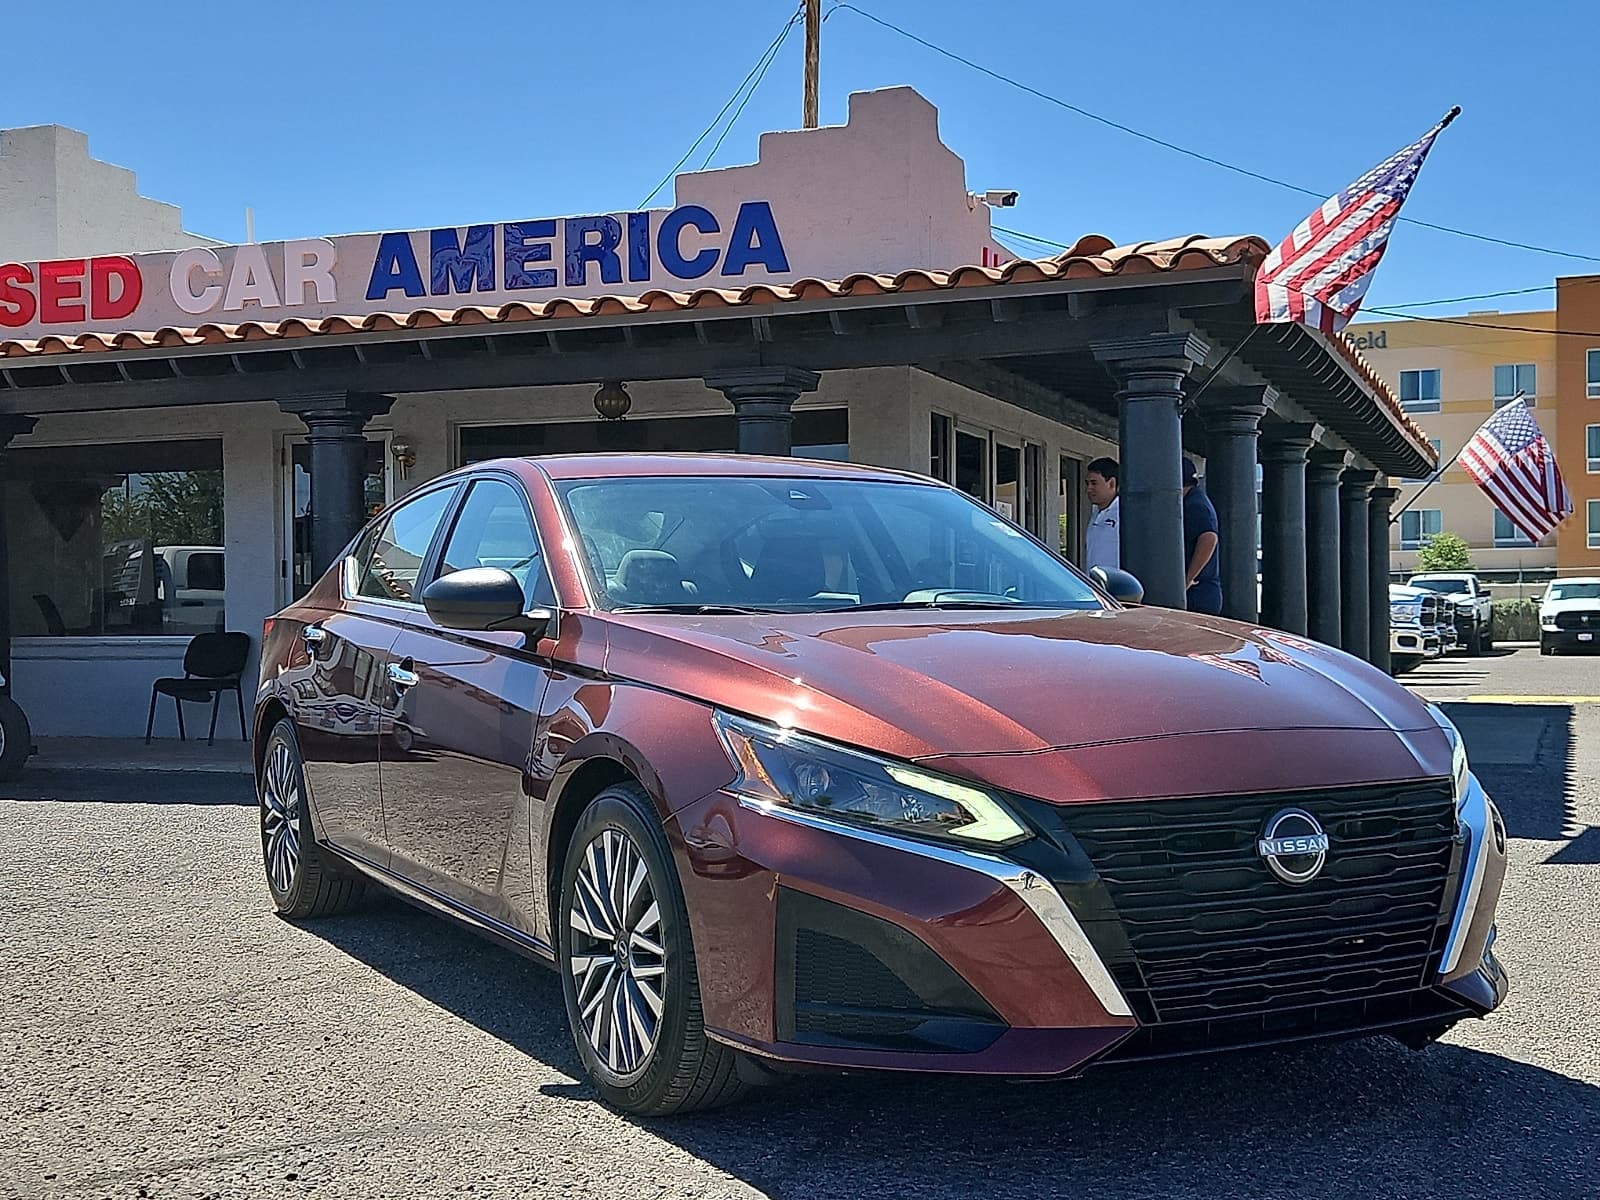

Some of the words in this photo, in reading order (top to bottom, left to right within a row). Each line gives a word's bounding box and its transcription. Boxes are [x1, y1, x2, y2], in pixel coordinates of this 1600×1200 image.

[0, 255, 143, 328] SED
[169, 238, 338, 315] CAR
[365, 201, 791, 301] AMERICA
[1261, 834, 1329, 853] NISSAN
